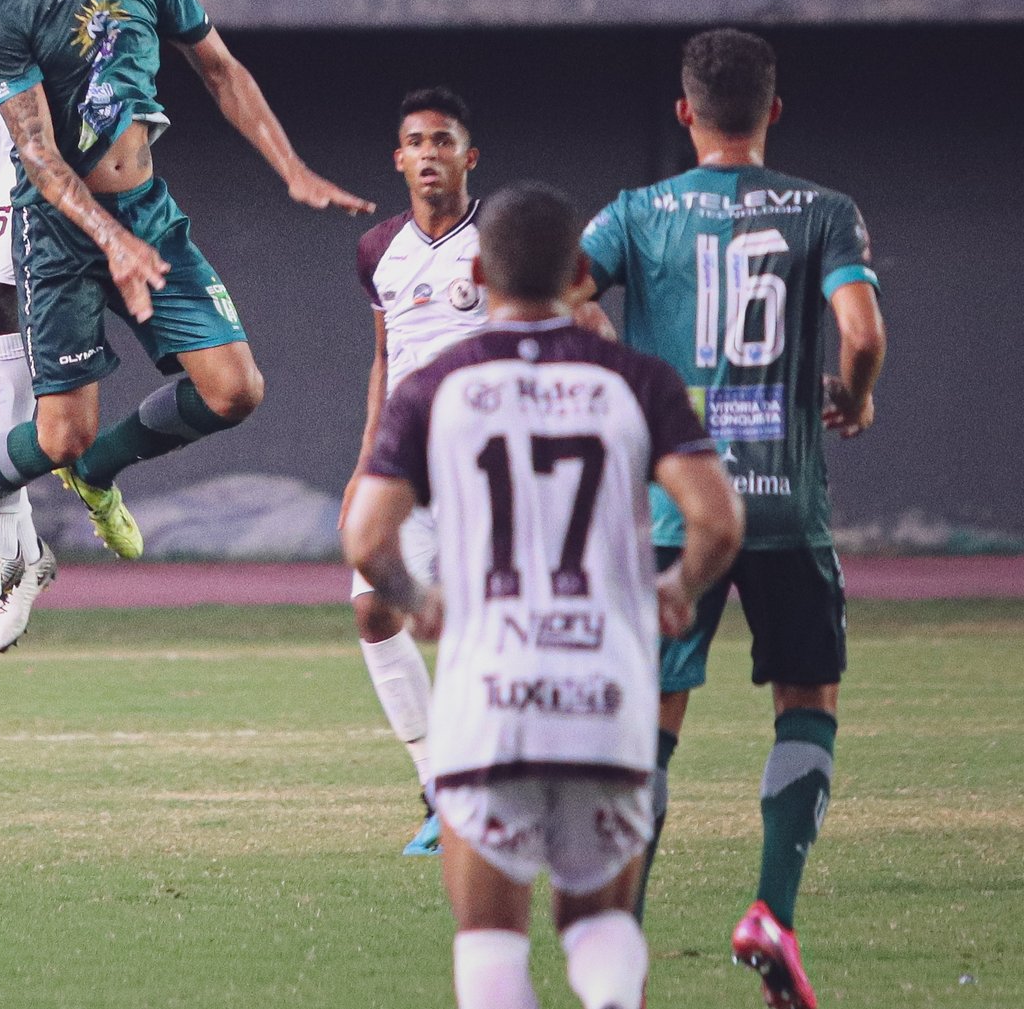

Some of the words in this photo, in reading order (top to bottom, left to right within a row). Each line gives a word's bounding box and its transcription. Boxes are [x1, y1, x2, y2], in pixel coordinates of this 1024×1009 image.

[682, 189, 818, 211] TELEVIT
[694, 228, 788, 368] 16
[709, 412, 782, 426] CONQUISTA
[476, 434, 606, 597] 17
